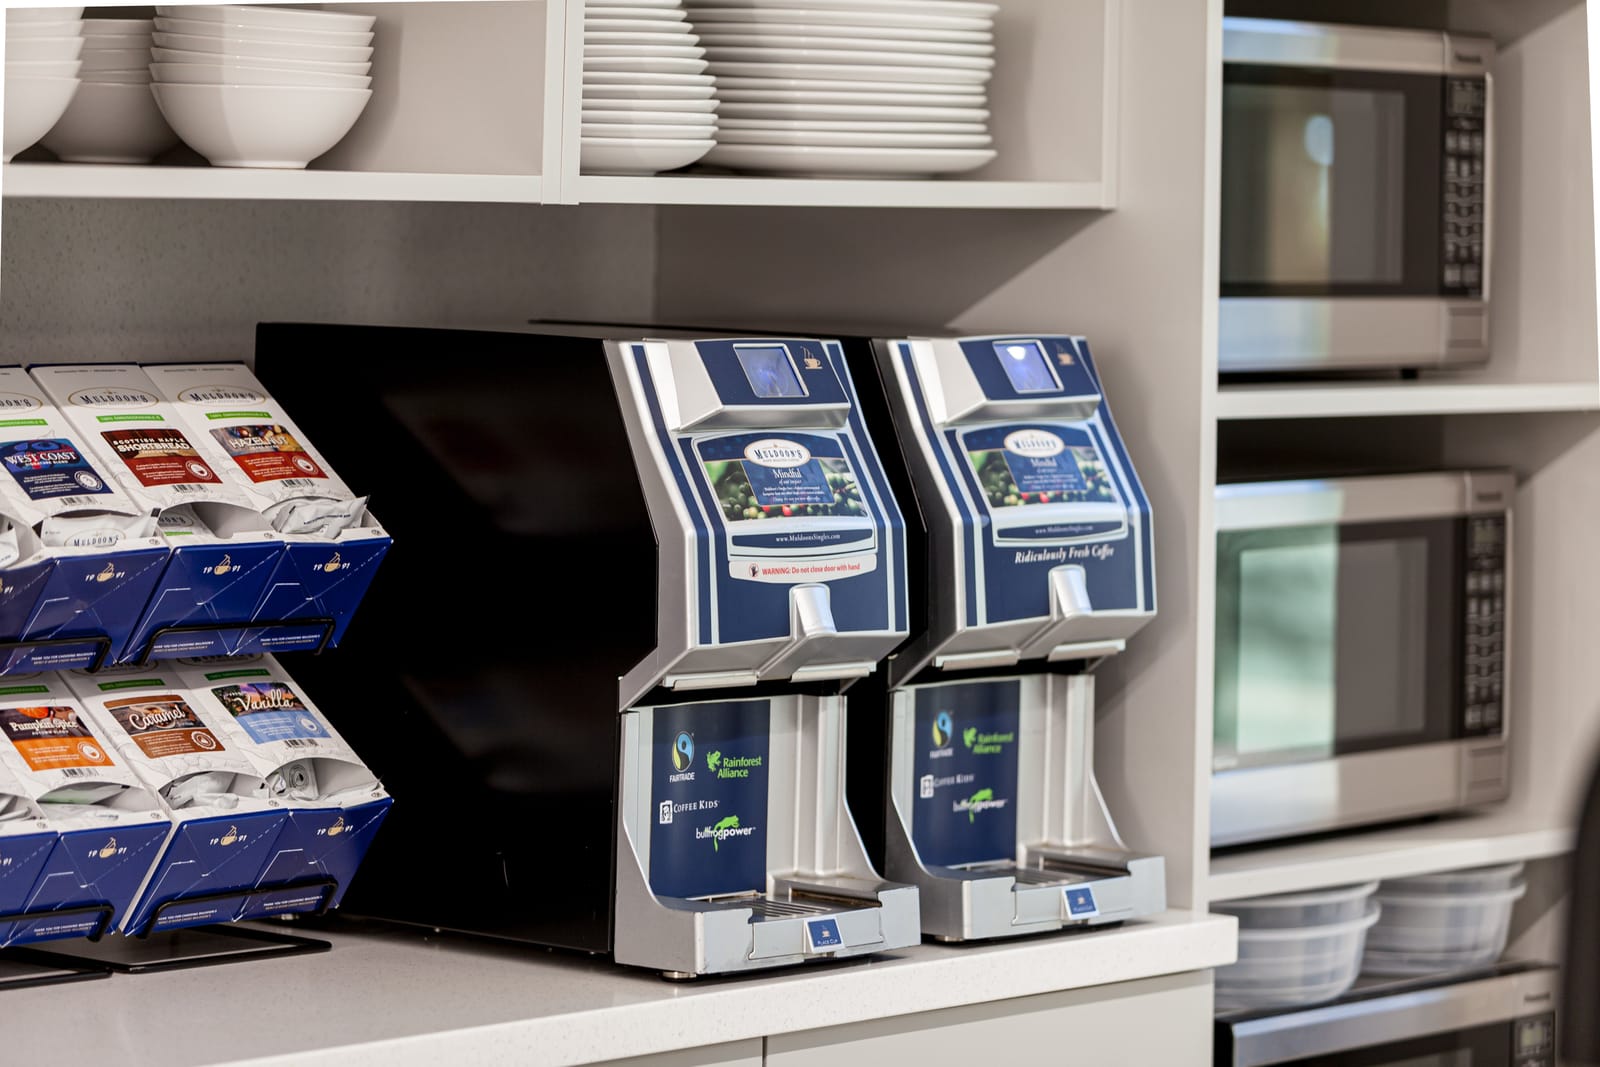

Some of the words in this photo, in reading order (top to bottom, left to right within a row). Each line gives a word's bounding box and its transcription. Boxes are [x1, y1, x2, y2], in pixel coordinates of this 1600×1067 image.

[79, 394, 149, 405] MULDOON'S
[189, 392, 257, 401] MULDOON'S
[113, 438, 155, 446] SCOTTISH
[117, 441, 190, 453] SHORTBREAD
[229, 436, 289, 449] HAZELNUT
[4, 453, 39, 465] WEST
[40, 451, 77, 461] COAST
[754, 449, 802, 459] MULDOON'S
[772, 468, 802, 479] Mindful
[1015, 547, 1067, 564] Ridiculously
[1069, 546, 1090, 559] Fresh
[1092, 544, 1114, 560] Coffee
[202, 565, 213, 575] 19
[231, 564, 241, 573] 91
[313, 563, 323, 572] 19
[341, 562, 351, 570] 91
[761, 566, 791, 576] WARNING:
[791, 566, 800, 574] Do
[800, 565, 810, 573] not
[810, 565, 824, 573] close
[824, 563, 837, 572] door
[837, 563, 847, 571] with
[847, 562, 861, 571] hand
[233, 688, 293, 711] Vanilla
[129, 704, 186, 730] Caramel
[9, 719, 54, 732] Pumpkin
[54, 718, 80, 730] Spice
[723, 756, 763, 768] Rainforest
[669, 772, 696, 783] FAIRTRADE
[717, 768, 749, 779] Alliance
[673, 802, 698, 813] COFFEE
[699, 800, 719, 810] KIDS
[317, 828, 326, 836] 19
[344, 825, 354, 833] 91
[695, 826, 753, 841] bullfrogpower
[209, 838, 219, 847] 19
[237, 834, 248, 843] 91
